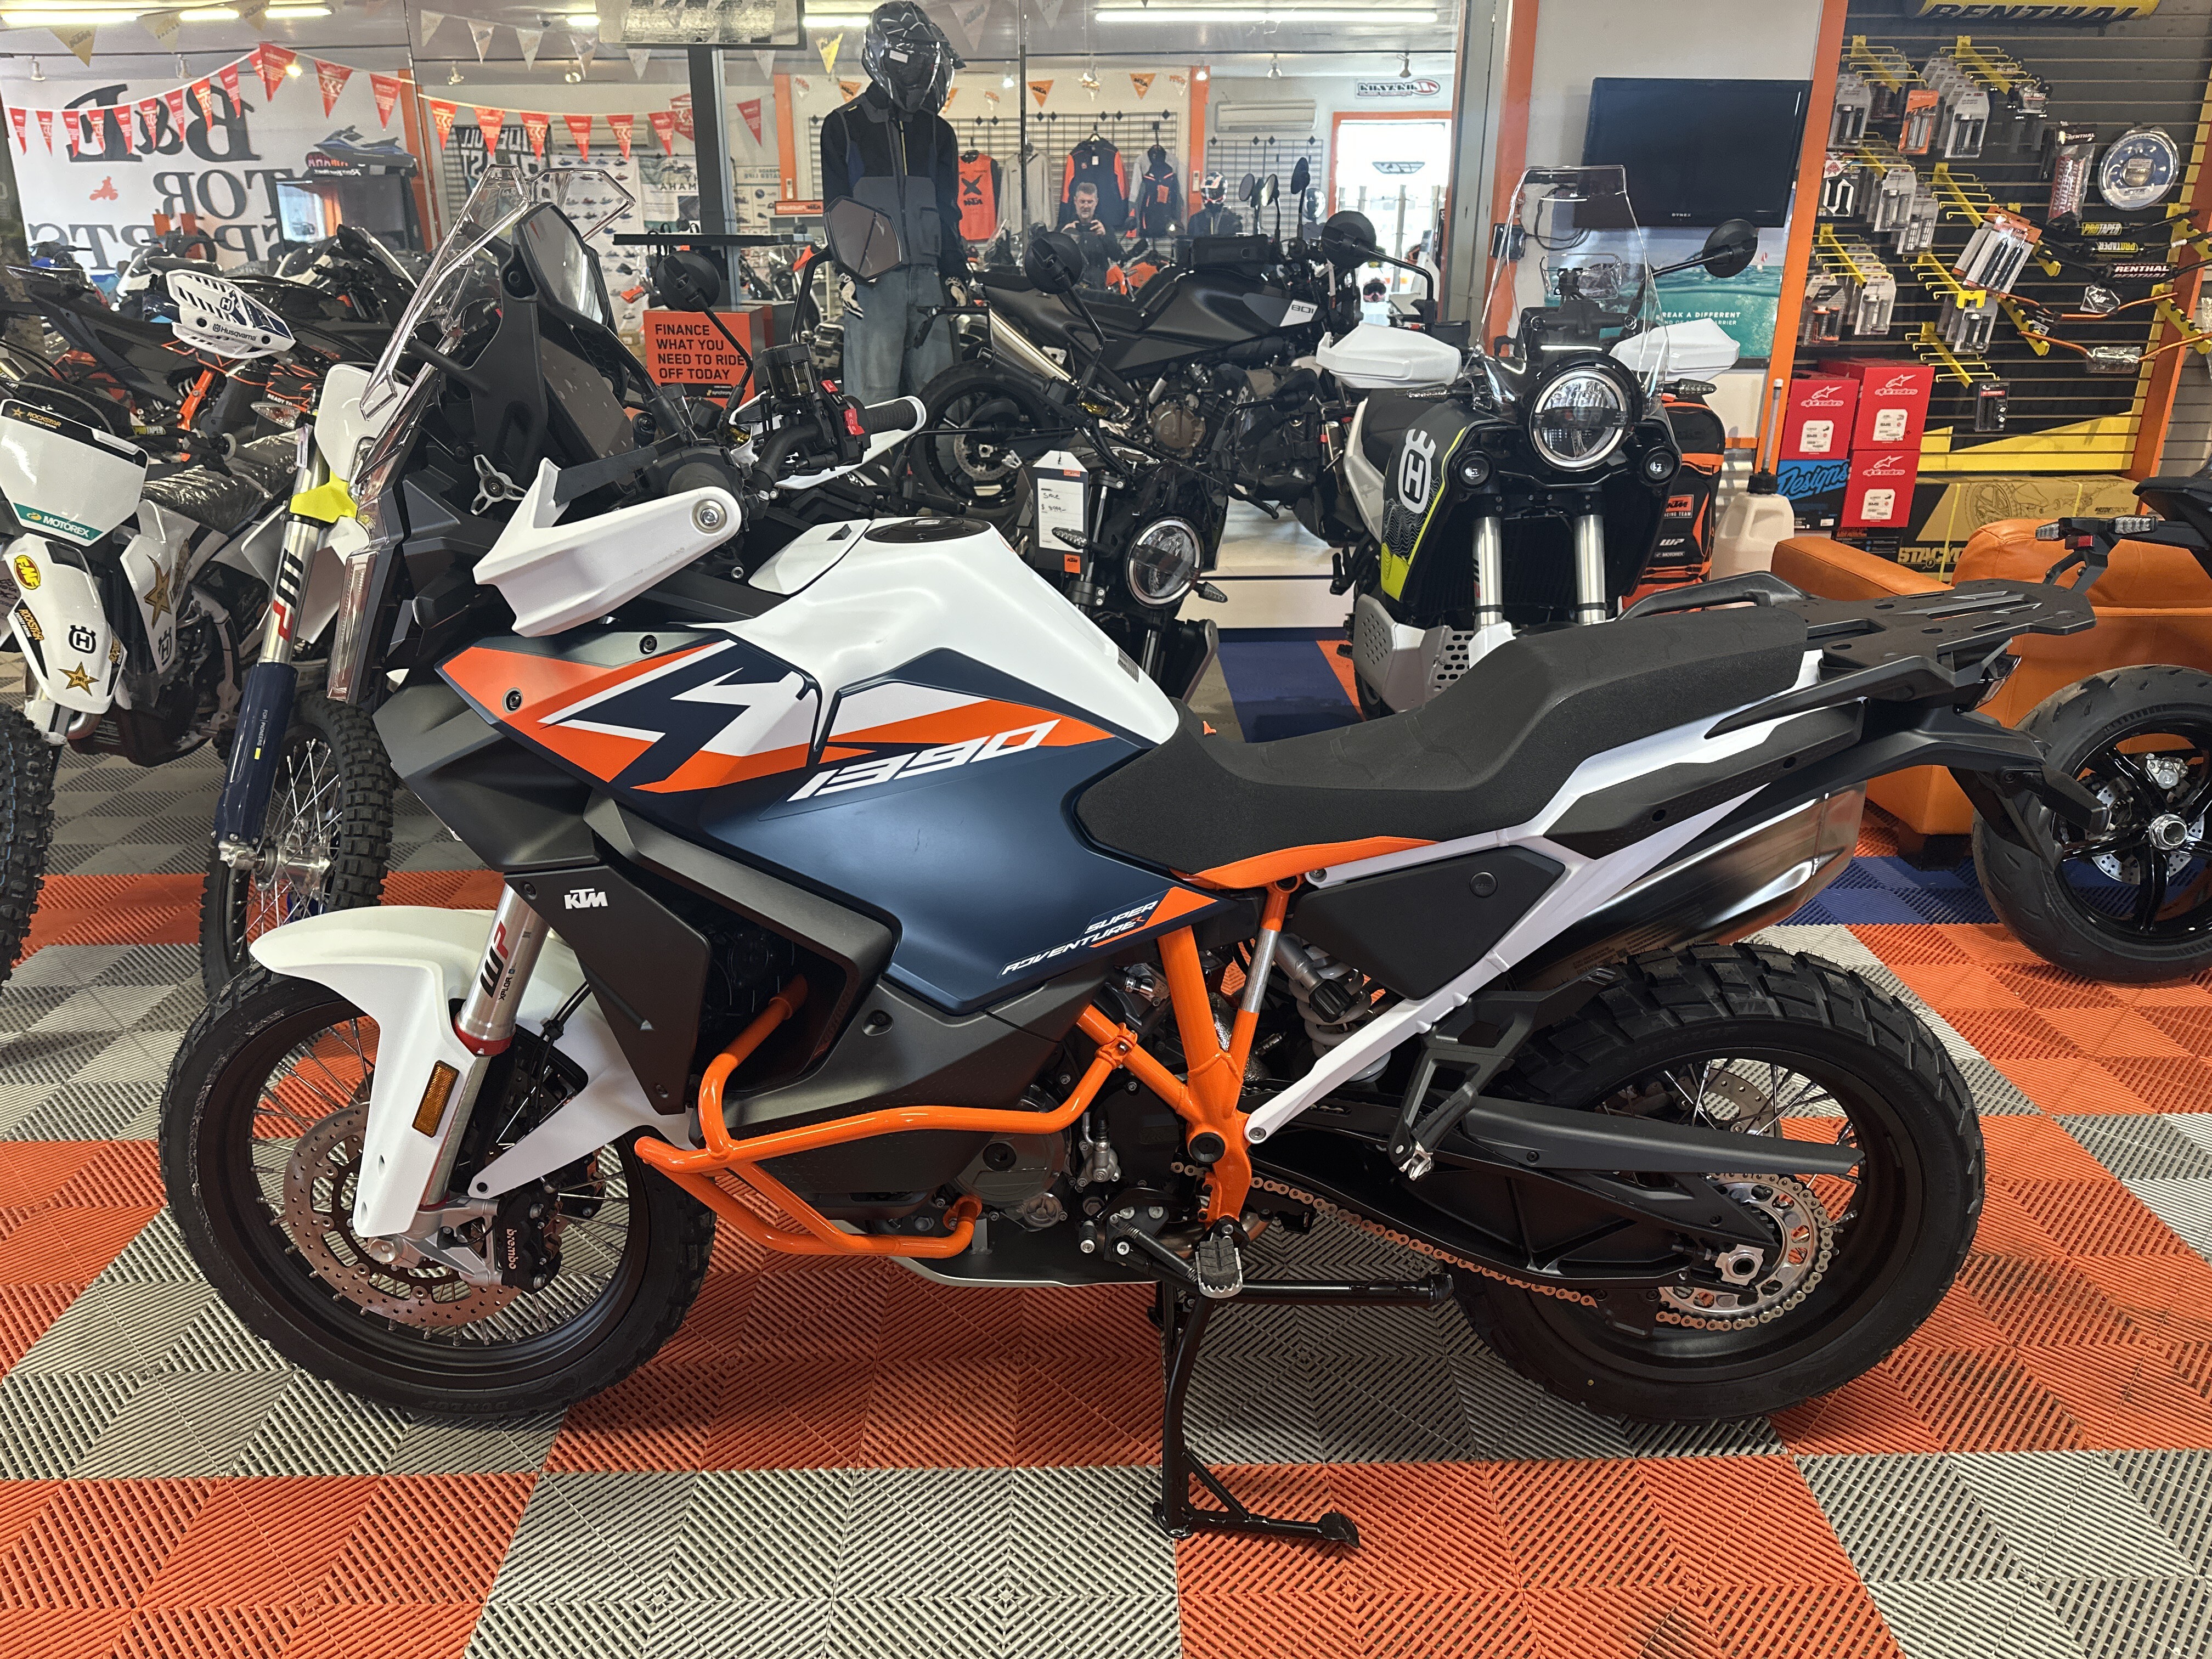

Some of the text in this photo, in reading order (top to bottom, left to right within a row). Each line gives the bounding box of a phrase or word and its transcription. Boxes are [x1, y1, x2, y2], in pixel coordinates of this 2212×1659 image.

[221, 326, 256, 341] Husqvarna
[655, 324, 710, 336] FINANCE
[656, 339, 724, 351] WHAT YOU
[658, 354, 745, 366] NEED TO RIDE
[659, 368, 730, 380] OFF TODAY
[27, 411, 61, 427] ROCKSTAR
[43, 516, 90, 537] MOTOREX
[787, 719, 1062, 802] 1390
[564, 888, 608, 910] KTM
[1085, 900, 1158, 934] SUPER
[479, 919, 509, 998] WP
[1001, 922, 1138, 976] ADVENTURE
[498, 976, 513, 1001] XPLOR
[506, 1228, 517, 1270] brembo
